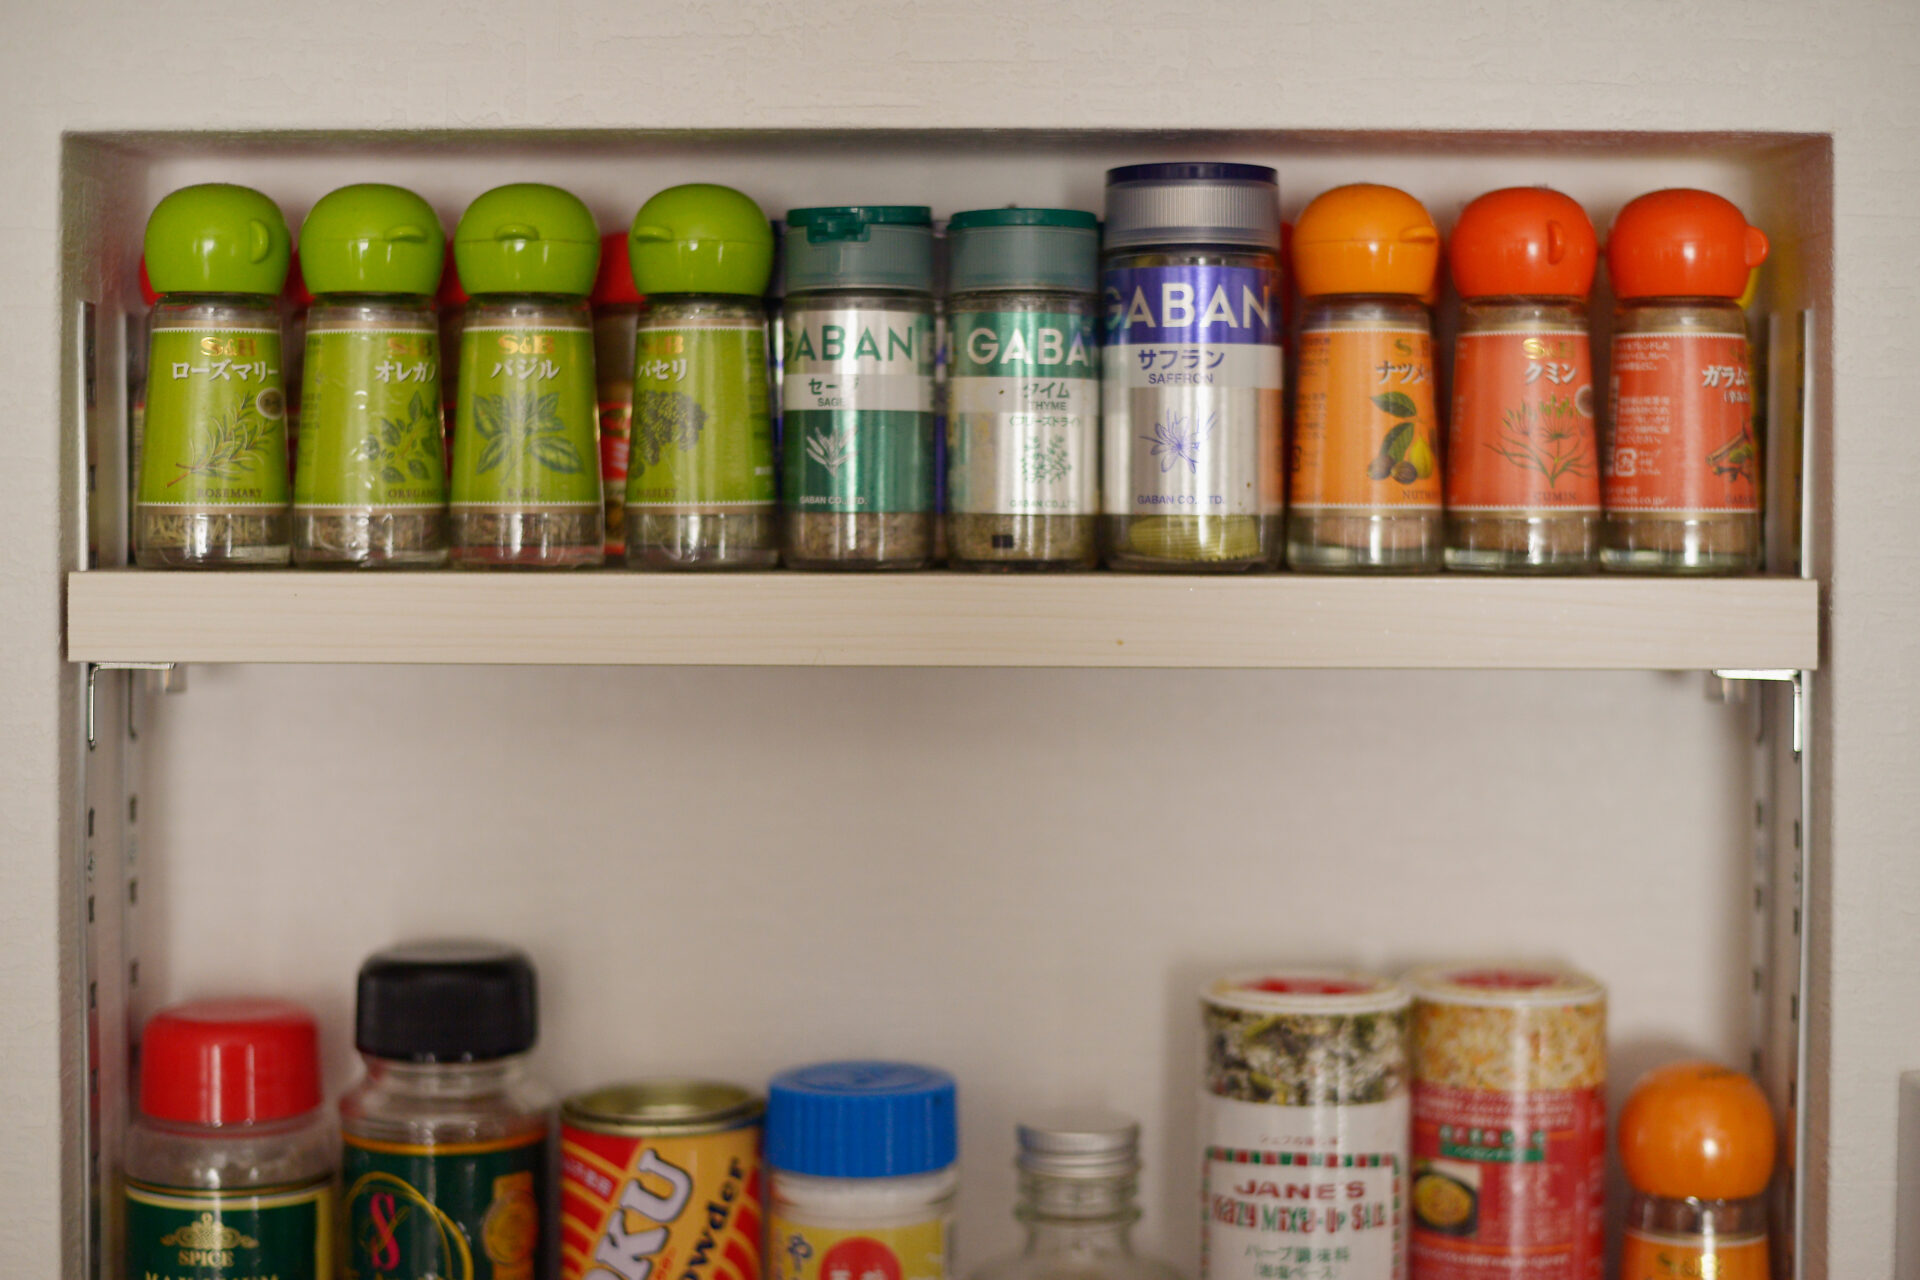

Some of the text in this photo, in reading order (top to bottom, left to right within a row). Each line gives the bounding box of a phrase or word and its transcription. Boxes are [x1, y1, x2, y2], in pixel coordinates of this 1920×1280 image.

[498, 335, 554, 354] S&B
[967, 327, 1095, 366] GABA
[490, 357, 561, 383] バジル
[1138, 349, 1225, 370] サフラン
[171, 359, 279, 384] ローズマリー
[1148, 373, 1214, 385] SAFFRON
[1376, 360, 1432, 385] ナツメ
[1524, 361, 1577, 385] クミン
[1701, 365, 1750, 388] ガラム
[808, 377, 859, 396] セー
[1034, 401, 1067, 411] HYME
[1137, 495, 1174, 505] GABAN
[583, 1147, 694, 1280] KU
[683, 1157, 744, 1280] wder
[178, 1250, 235, 1267] SPICE
